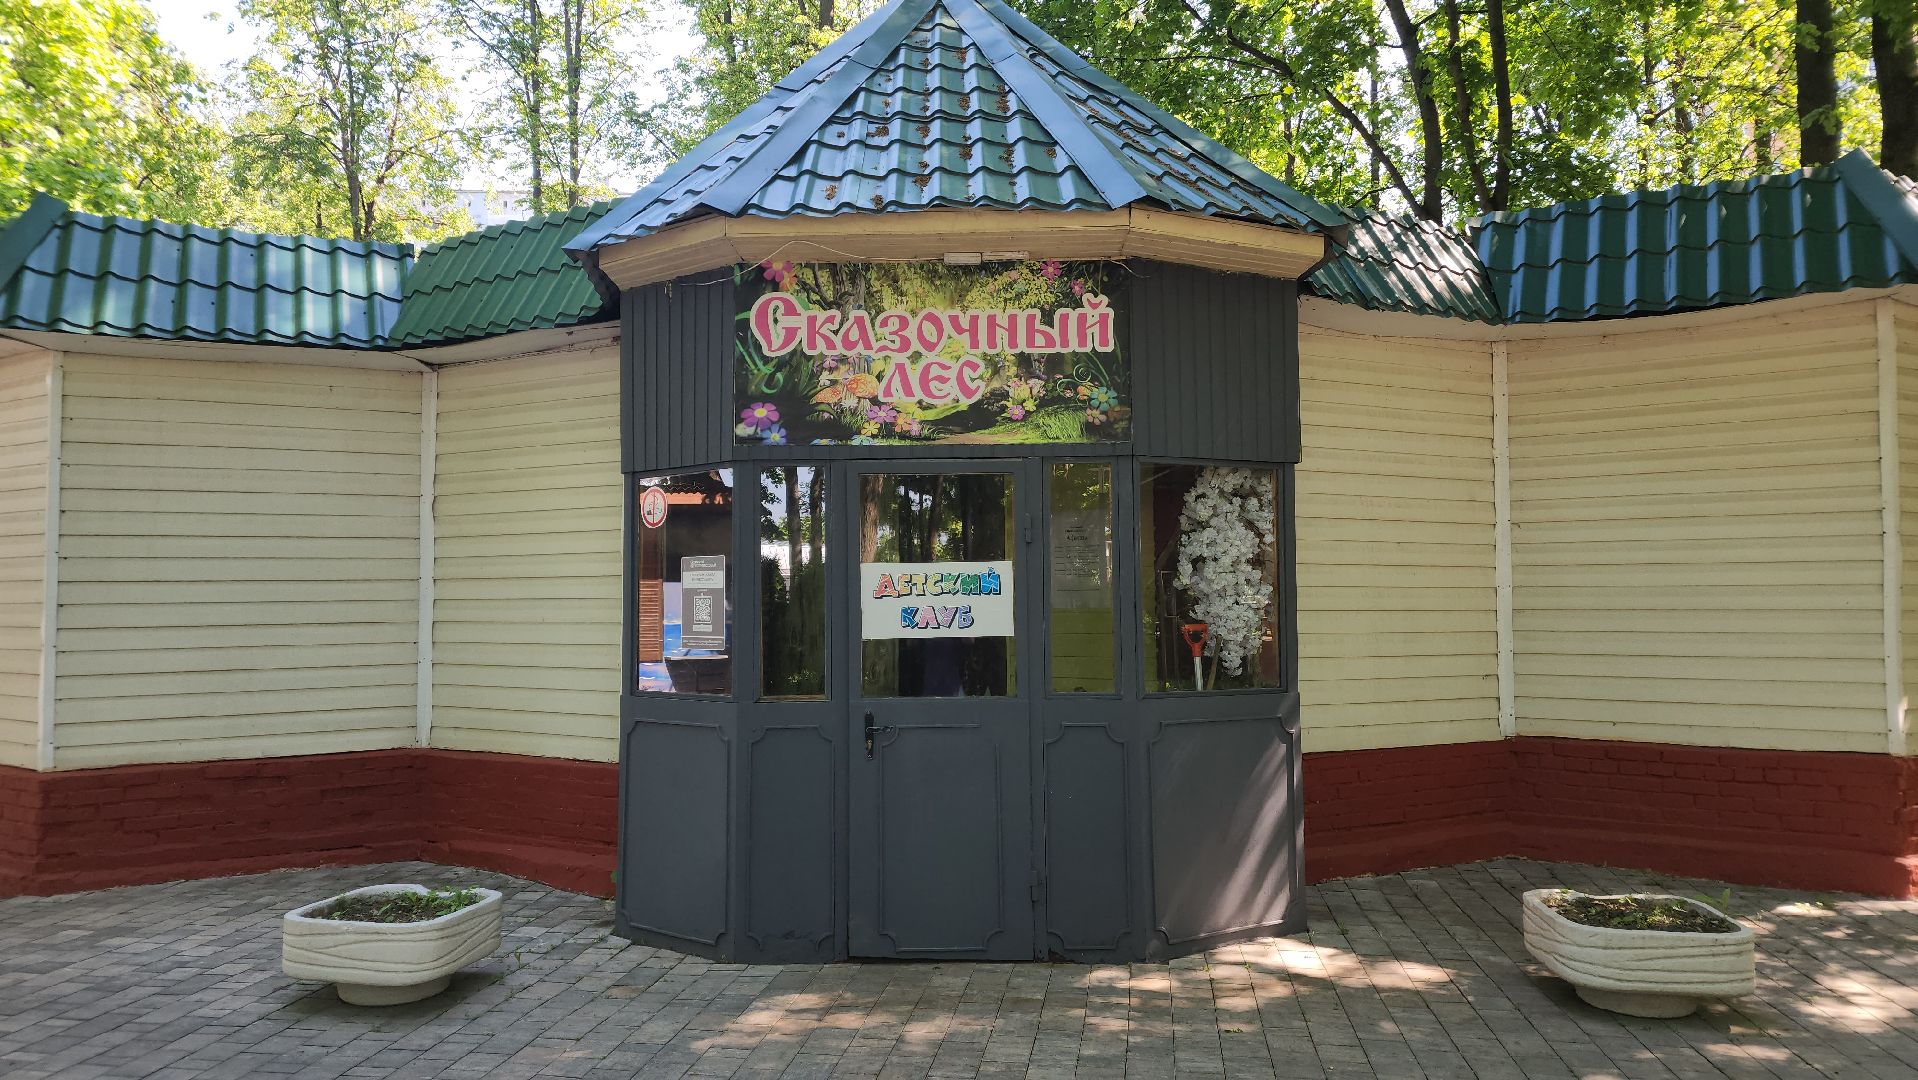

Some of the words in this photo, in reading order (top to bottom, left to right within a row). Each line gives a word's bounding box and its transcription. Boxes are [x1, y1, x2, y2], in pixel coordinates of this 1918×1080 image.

[752, 294, 1113, 354] Сказочный
[873, 567, 1002, 599] ДЕТСКИЙ
[900, 605, 975, 629] КЛУБ
